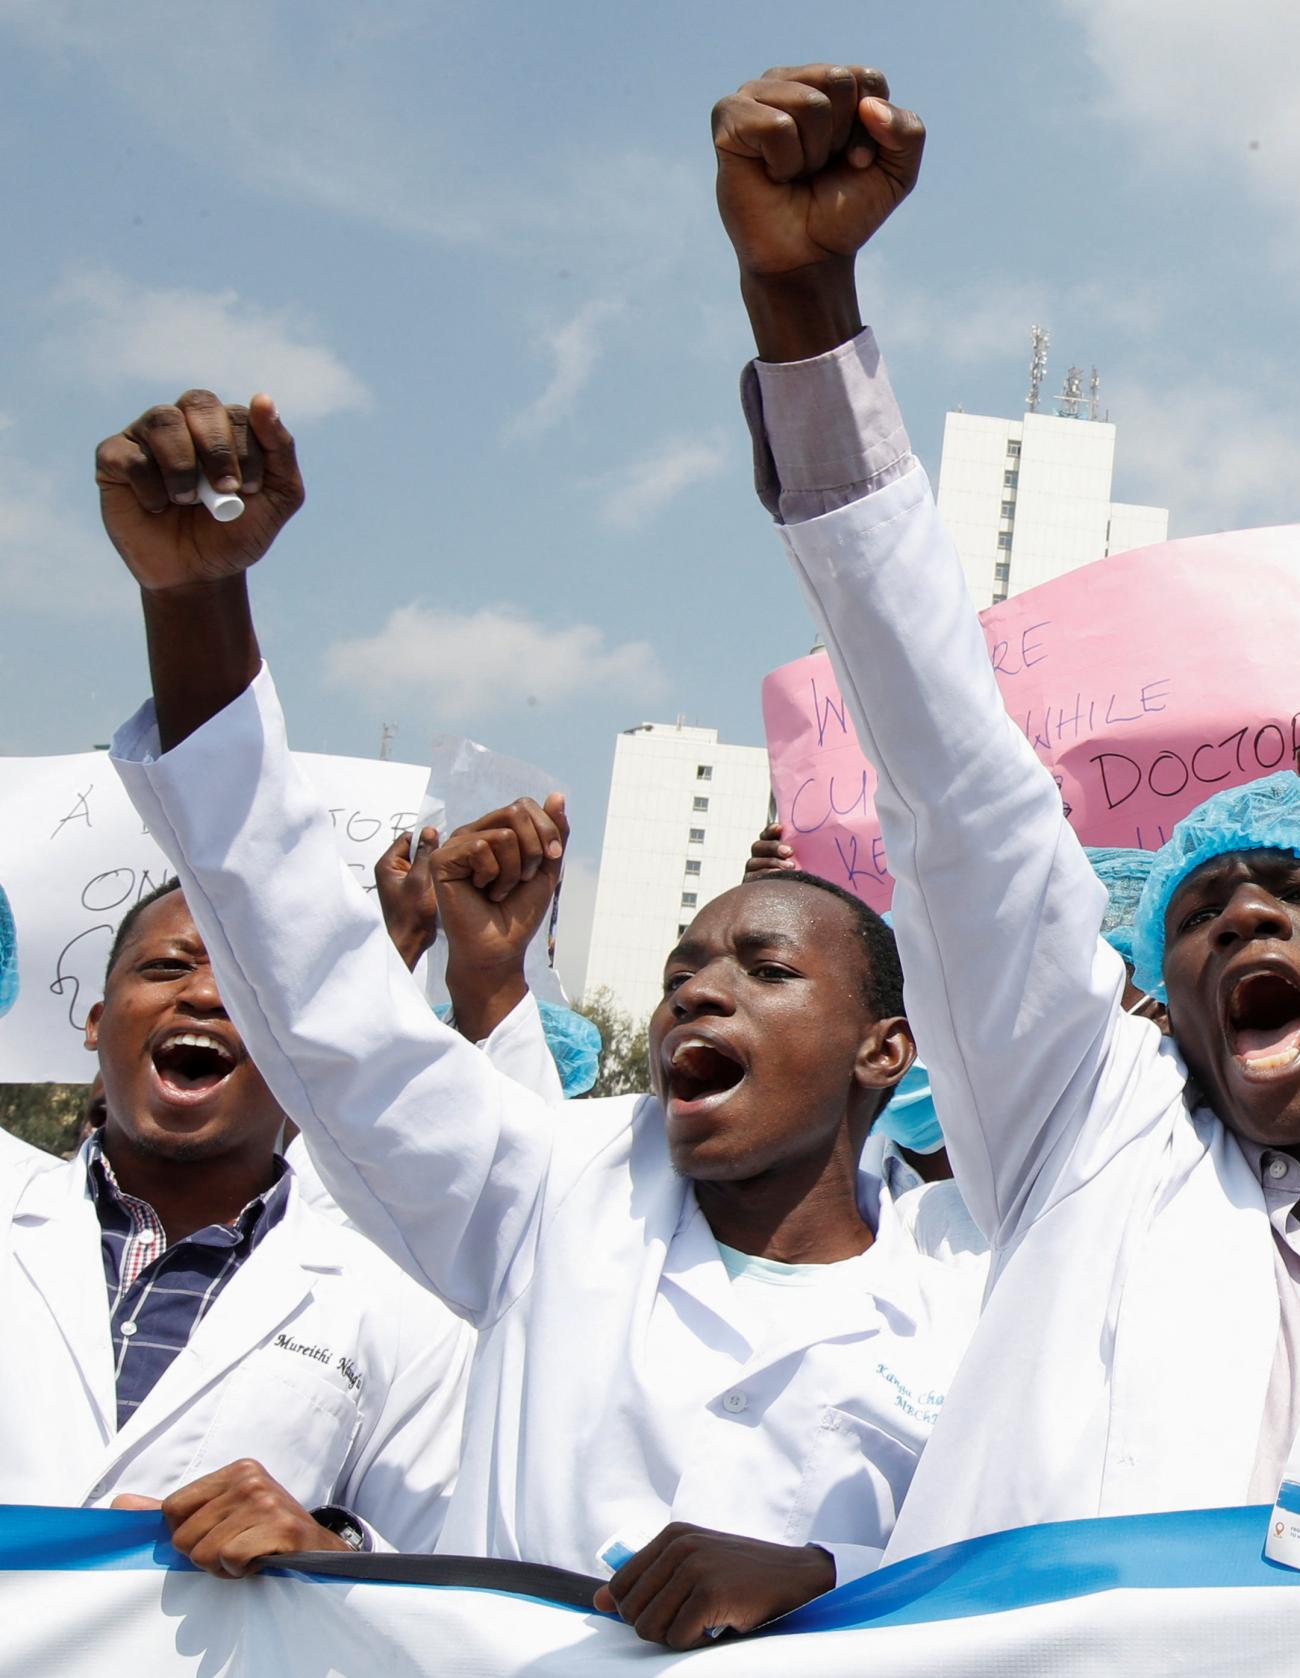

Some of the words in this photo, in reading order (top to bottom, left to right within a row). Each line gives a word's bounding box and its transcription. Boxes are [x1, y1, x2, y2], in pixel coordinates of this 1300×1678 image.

[1026, 678, 1171, 749] WHILE
[50, 784, 93, 840] A
[273, 1333, 334, 1365] Mureithi
